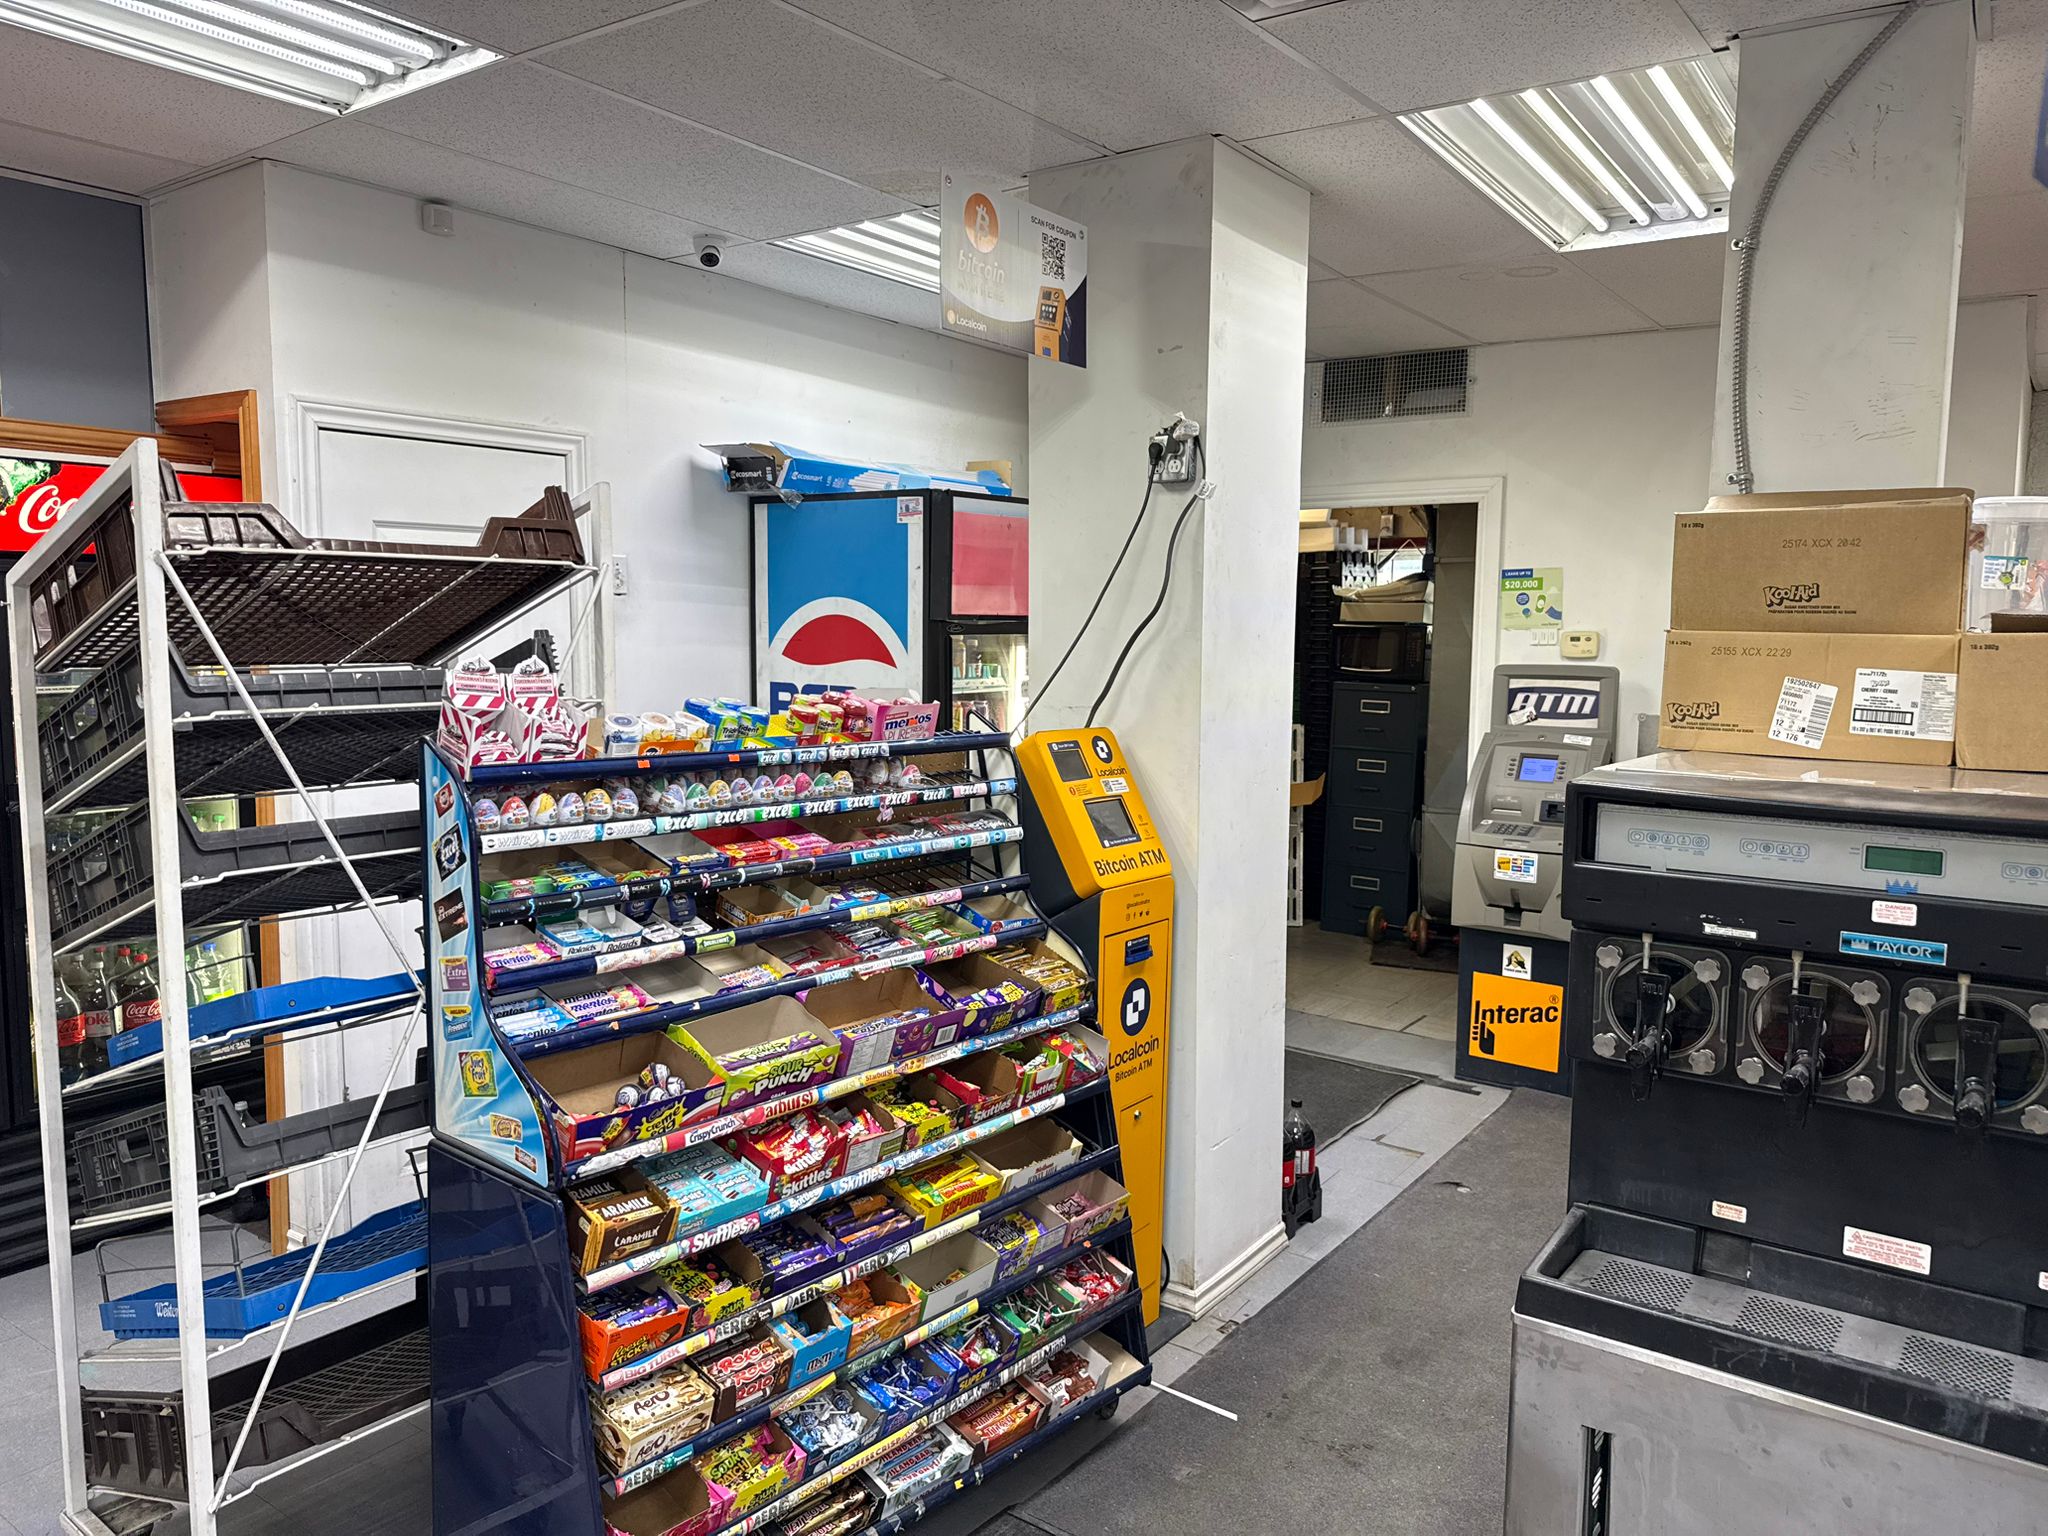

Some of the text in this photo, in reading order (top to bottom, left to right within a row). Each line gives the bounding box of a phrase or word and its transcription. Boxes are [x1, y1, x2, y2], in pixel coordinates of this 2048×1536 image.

[1030, 216, 1076, 240] SCAN FOR COUPON
[958, 249, 1005, 284] bitcoin
[956, 314, 988, 332] Localcoin
[1782, 539, 1808, 549] 25174
[1812, 538, 1832, 548] XCX
[1504, 580, 1538, 589] $20,000
[1763, 583, 1820, 608] Kool-Aid
[1711, 646, 1792, 658] 25155 XCX 22:29
[1510, 692, 1598, 715] ATM
[1667, 701, 1720, 722] Kool-Aid
[1776, 718, 1784, 727] 12
[1772, 730, 1798, 742] 12 176
[1096, 765, 1128, 778] Localcoin
[664, 814, 698, 830] excel
[715, 810, 747, 826] excel
[762, 804, 793, 820] excel
[806, 800, 835, 814] excel
[846, 796, 874, 808] excel
[885, 794, 912, 805] excel
[924, 789, 946, 800] excel
[1094, 848, 1166, 876] Bitcoin ATM
[568, 944, 597, 956] Rolaids
[606, 939, 638, 953] Rolaids
[1873, 941, 1931, 958] TAYLOR
[446, 968, 468, 978] Extra
[493, 1007, 525, 1018] entos
[1475, 1000, 1558, 1024] Interac
[526, 1026, 556, 1038] entos
[1108, 1036, 1159, 1070] Localcoin
[768, 1058, 804, 1078] SOUR
[1114, 1057, 1153, 1083] Bitcoin ATM
[754, 1066, 814, 1096] PUNCH
[1024, 1082, 1057, 1102] Skittles
[764, 1090, 812, 1118] arburst
[974, 1100, 1012, 1122] Skittles
[646, 1106, 681, 1132] creme
[650, 1118, 676, 1138] egg
[571, 1180, 616, 1201] RAMILK
[781, 1167, 833, 1198] Skittles
[838, 1166, 886, 1192] Skittles
[614, 1226, 659, 1247] CARAMILK
[694, 1218, 750, 1252] Skittles
[610, 1342, 650, 1368] STICKS
[624, 1346, 682, 1379] BIG TURK
[718, 1345, 760, 1374] ROLO
[731, 1358, 774, 1386] ROLO
[960, 1368, 988, 1391] SUPER
[736, 1374, 774, 1396] ROLO
[634, 1389, 670, 1416] Aero
[636, 1434, 666, 1462] Aero
[914, 1450, 932, 1464] BAR
[712, 1450, 742, 1479] SOUR
[716, 1462, 750, 1487] PATCH
[842, 1453, 876, 1475] COFFEE
